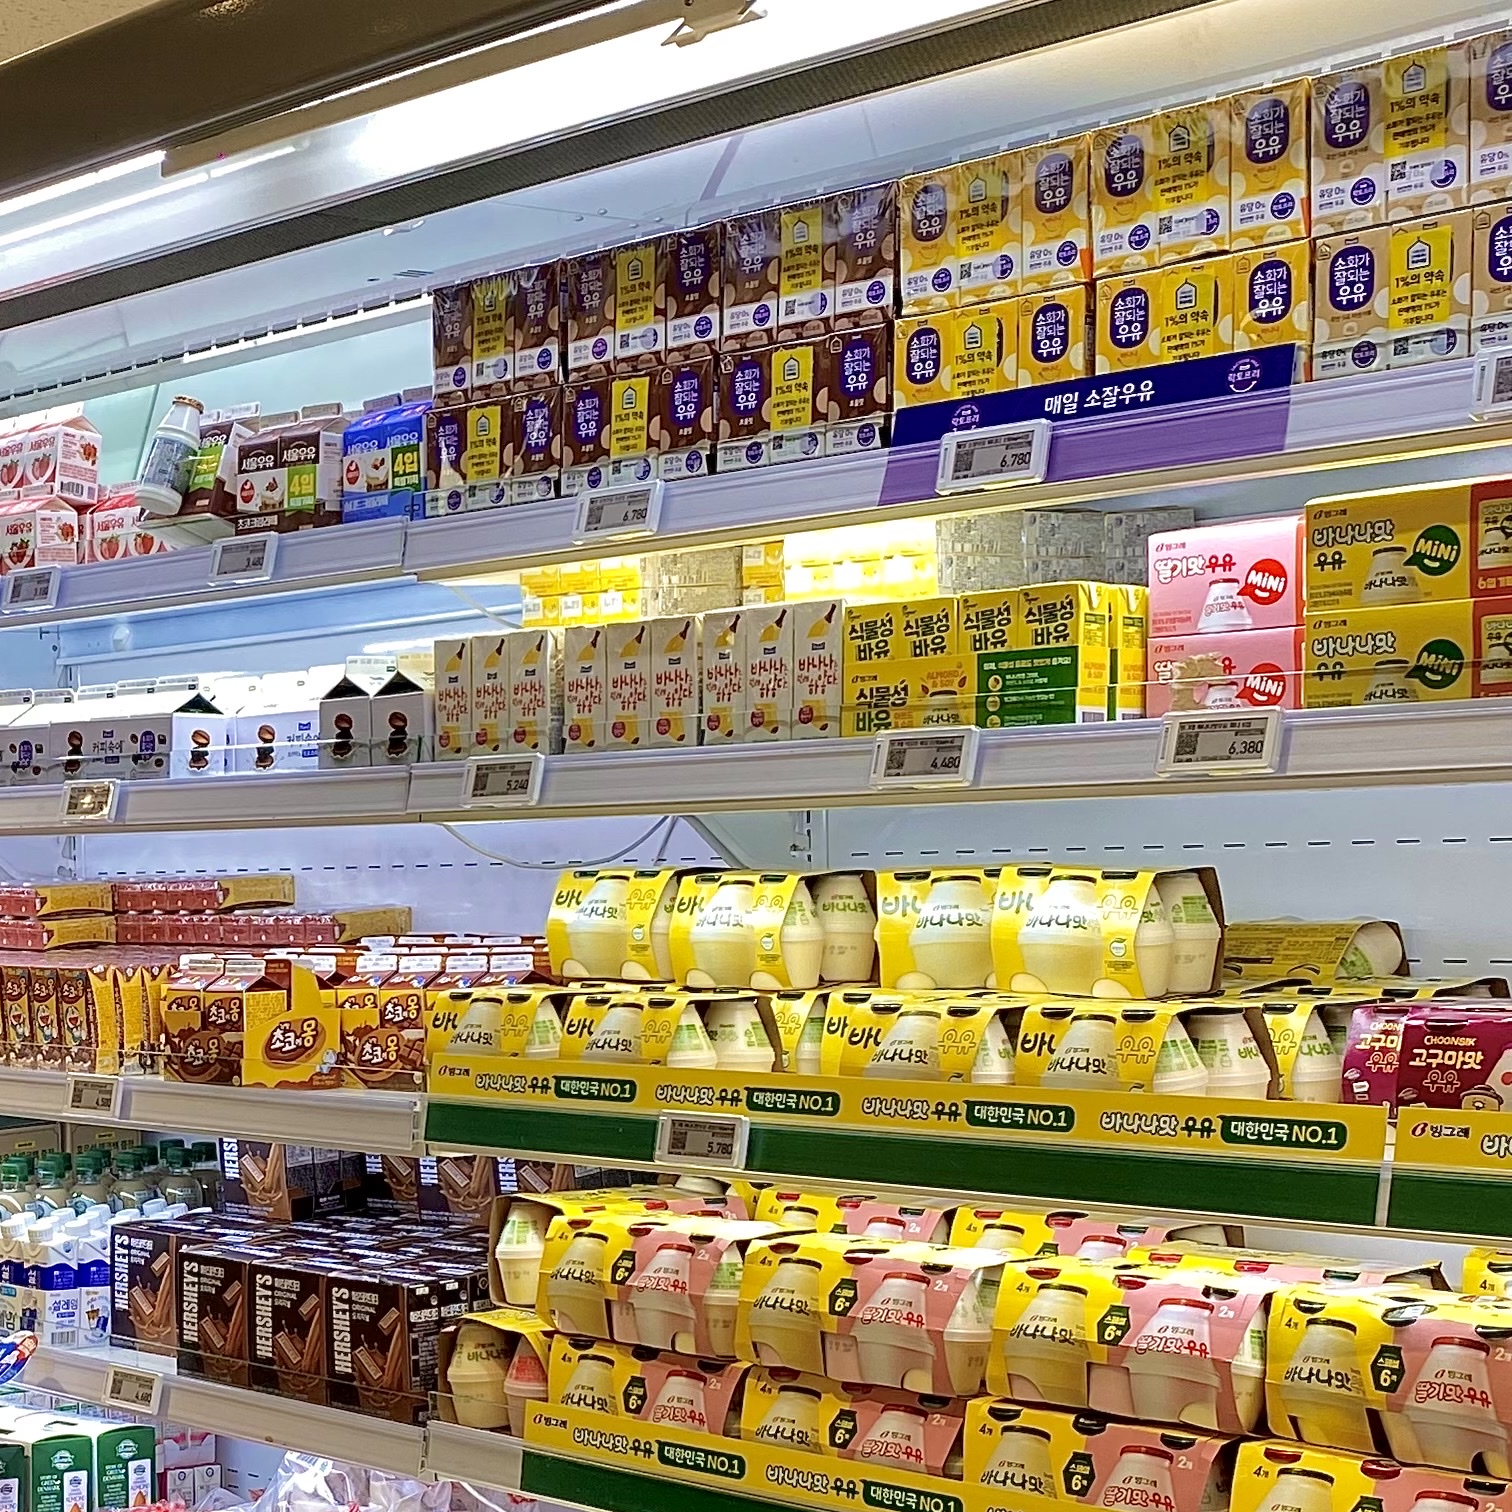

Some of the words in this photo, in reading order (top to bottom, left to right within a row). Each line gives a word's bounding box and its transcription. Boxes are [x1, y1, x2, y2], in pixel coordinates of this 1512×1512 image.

[1252, 136, 1282, 158] 우유
[1334, 253, 1370, 270] 소화가
[1253, 265, 1287, 284] 소화가
[1334, 268, 1370, 286] 잘되는
[1395, 273, 1420, 289] 1%의
[1253, 281, 1288, 299] 잘되는
[1336, 284, 1367, 305] 우유
[1036, 310, 1065, 325] 소화가
[1255, 296, 1285, 318] 우유
[1036, 323, 1065, 340] 잘되는
[1037, 337, 1063, 357] 우유
[845, 374, 869, 391] 우유
[1044, 391, 1079, 414] 매일
[1083, 379, 1155, 409] 소잘우유
[241, 454, 275, 470] 서울우유
[282, 446, 316, 462] 서울우유
[393, 452, 418, 475] 4입
[289, 475, 314, 496] 4입
[1312, 518, 1395, 548] 바나나맛
[1154, 555, 1205, 584] 딸기맛
[1205, 553, 1237, 574] 우유
[1313, 551, 1347, 572] 우유
[1025, 594, 1074, 625] 식물성
[903, 607, 950, 637] 식물성
[913, 634, 946, 657] 바유
[1034, 622, 1070, 646] 바유
[1312, 631, 1396, 658] 바나나맛
[1313, 661, 1347, 682] 우유
[1098, 888, 1139, 919] 우유
[1119, 1036, 1156, 1065] 우유
[1424, 1036, 1476, 1046] CHOONSIK
[1047, 1055, 1107, 1075] 바나나맛
[1409, 1049, 1483, 1069] 고구마맛
[448, 1067, 470, 1077] 빙그레
[1423, 1070, 1461, 1092] 우유
[475, 1073, 526, 1093] 바나나맛
[528, 1076, 551, 1093] 우유
[560, 1079, 599, 1095] 대한민국
[601, 1082, 631, 1098] NO.1
[656, 1084, 715, 1106] 바나나맛
[716, 1087, 742, 1106] 우유
[753, 1090, 797, 1109] 대한민국
[799, 1094, 834, 1113] NO.1
[863, 1098, 929, 1120] 바나나맛
[932, 1101, 961, 1121] 우유
[975, 1106, 1025, 1123] 대한민국
[1027, 1108, 1067, 1128] NO.1
[1101, 1112, 1178, 1137] 바나나맛
[1180, 1116, 1216, 1138] 우유
[1230, 1121, 1289, 1140] 대한민국
[1291, 1124, 1338, 1145] NO.1
[1430, 1124, 1470, 1139] 빙그레
[115, 1234, 129, 1310] HERSHEY'S
[183, 1261, 199, 1342] HERSHEY'S
[256, 1273, 273, 1358] HERSHEY'S
[332, 1286, 351, 1374] HERSHEY'S
[1010, 1319, 1077, 1347] 바나나맛
[1135, 1334, 1182, 1356] 딸기맛
[1183, 1339, 1209, 1359] 우유
[1285, 1363, 1353, 1391] 바나나맛
[1415, 1380, 1462, 1403] 딸기맛
[1463, 1387, 1492, 1408] 우유
[546, 1415, 568, 1430] 빙그레
[573, 1428, 628, 1456] 바나나맛
[630, 1436, 655, 1458] 우유
[666, 1446, 706, 1468] 대한민국
[707, 1453, 741, 1475] NO.1
[767, 1464, 831, 1494] 바나나맛
[831, 1476, 859, 1500] 우유
[871, 1484, 918, 1510] 대한민국
